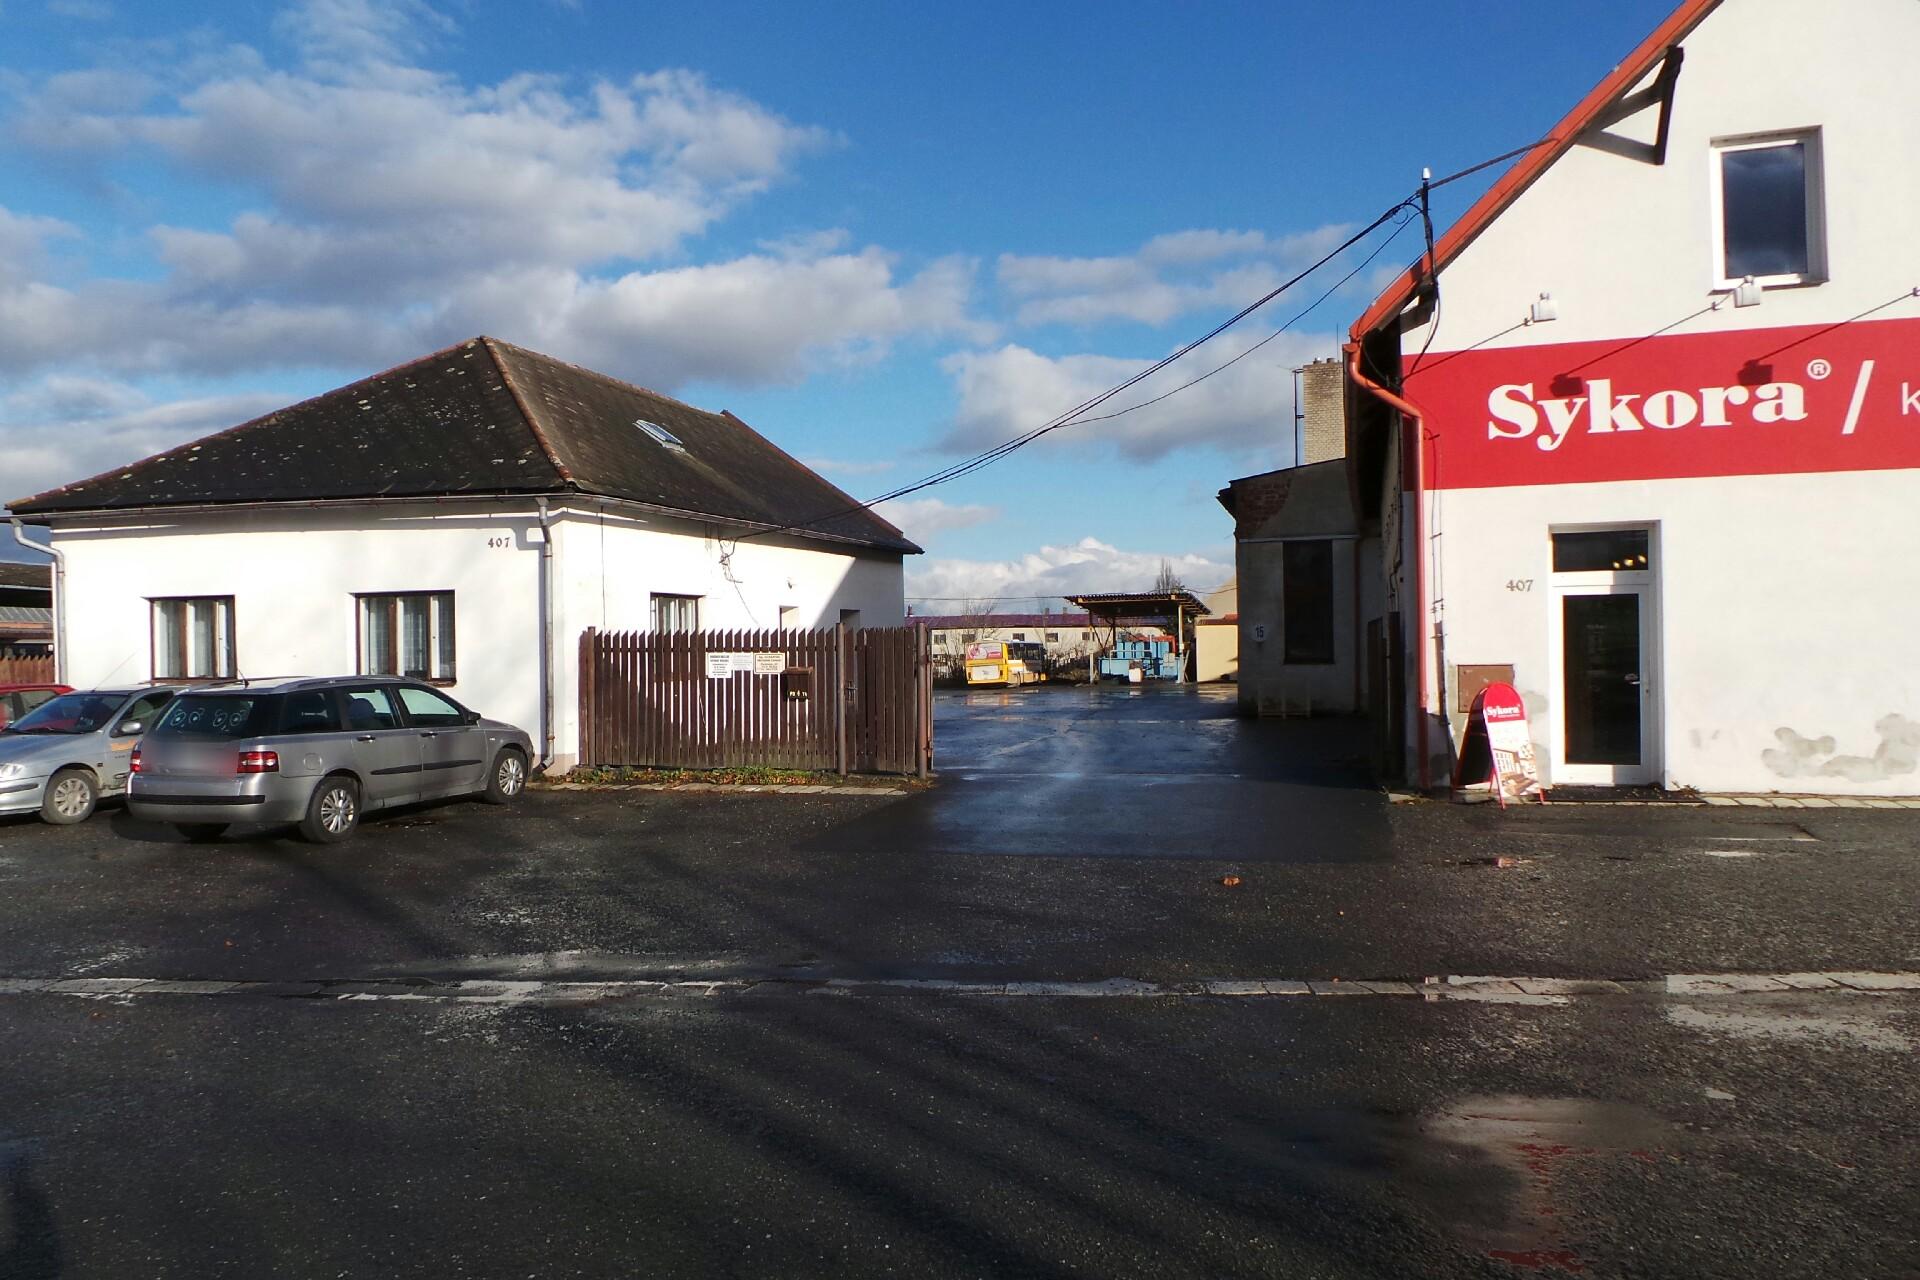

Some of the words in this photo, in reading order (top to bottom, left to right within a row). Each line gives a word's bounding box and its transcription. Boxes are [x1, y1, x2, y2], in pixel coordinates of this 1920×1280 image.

[488, 537, 510, 548] 407
[1506, 579, 1534, 592] 407
[1255, 626, 1264, 638] 15
